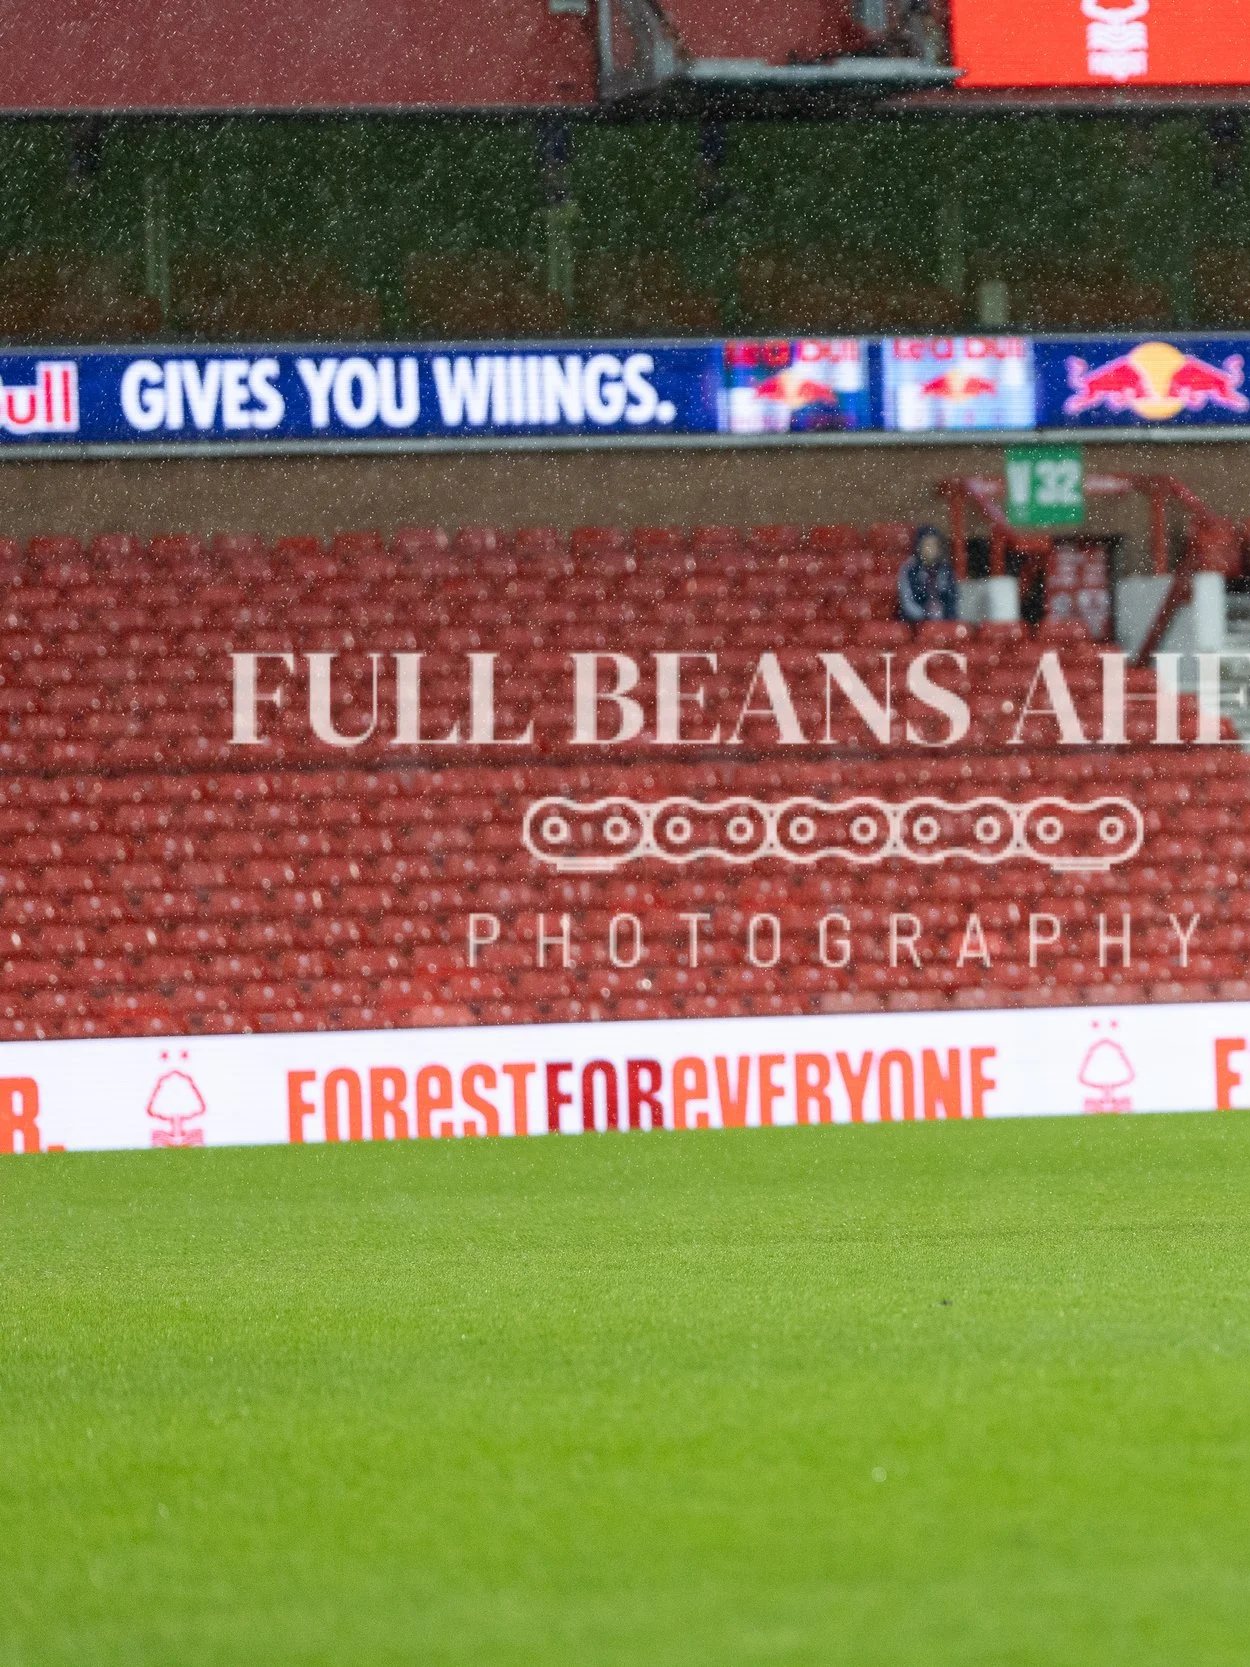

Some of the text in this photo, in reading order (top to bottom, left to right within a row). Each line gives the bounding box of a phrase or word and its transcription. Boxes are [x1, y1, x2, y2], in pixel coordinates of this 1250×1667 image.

[5, 366, 74, 427] ull
[120, 353, 677, 431] GIVES YOU WIIINGS.
[1035, 459, 1082, 506] 32
